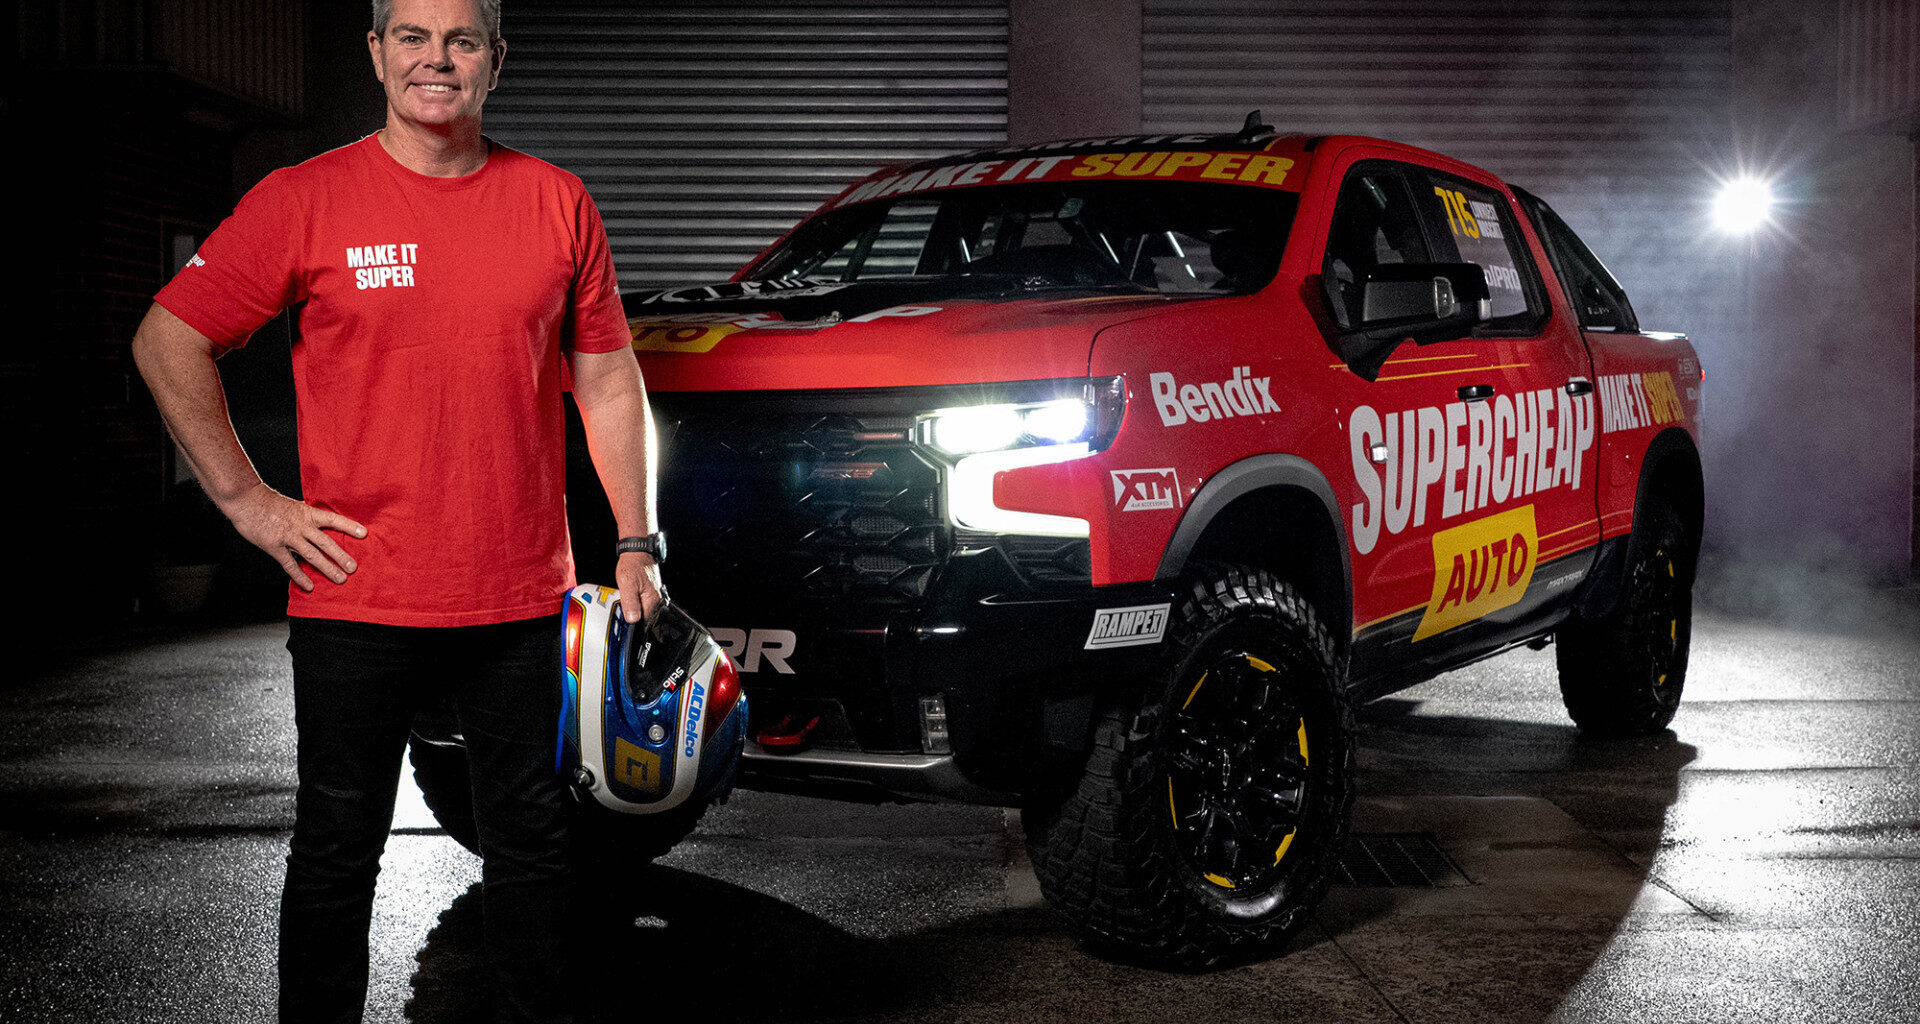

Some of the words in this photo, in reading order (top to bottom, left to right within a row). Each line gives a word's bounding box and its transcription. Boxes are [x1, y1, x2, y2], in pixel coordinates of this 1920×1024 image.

[834, 160, 1005, 208] MAKE
[997, 155, 1075, 181] IT
[1071, 152, 1295, 185] SUPER
[1434, 186, 1480, 239] 715
[346, 246, 398, 268] MAKE
[400, 243, 418, 264] IT
[355, 265, 415, 290] SUPER
[1150, 366, 1281, 427] Bendix
[1598, 373, 1639, 434] MAKE
[1630, 373, 1652, 427] IT
[1114, 471, 1177, 510] XTM
[1350, 377, 1595, 555] SUPERCHEAP
[1435, 533, 1528, 614] AUTO
[680, 681, 705, 758] ACDelco
